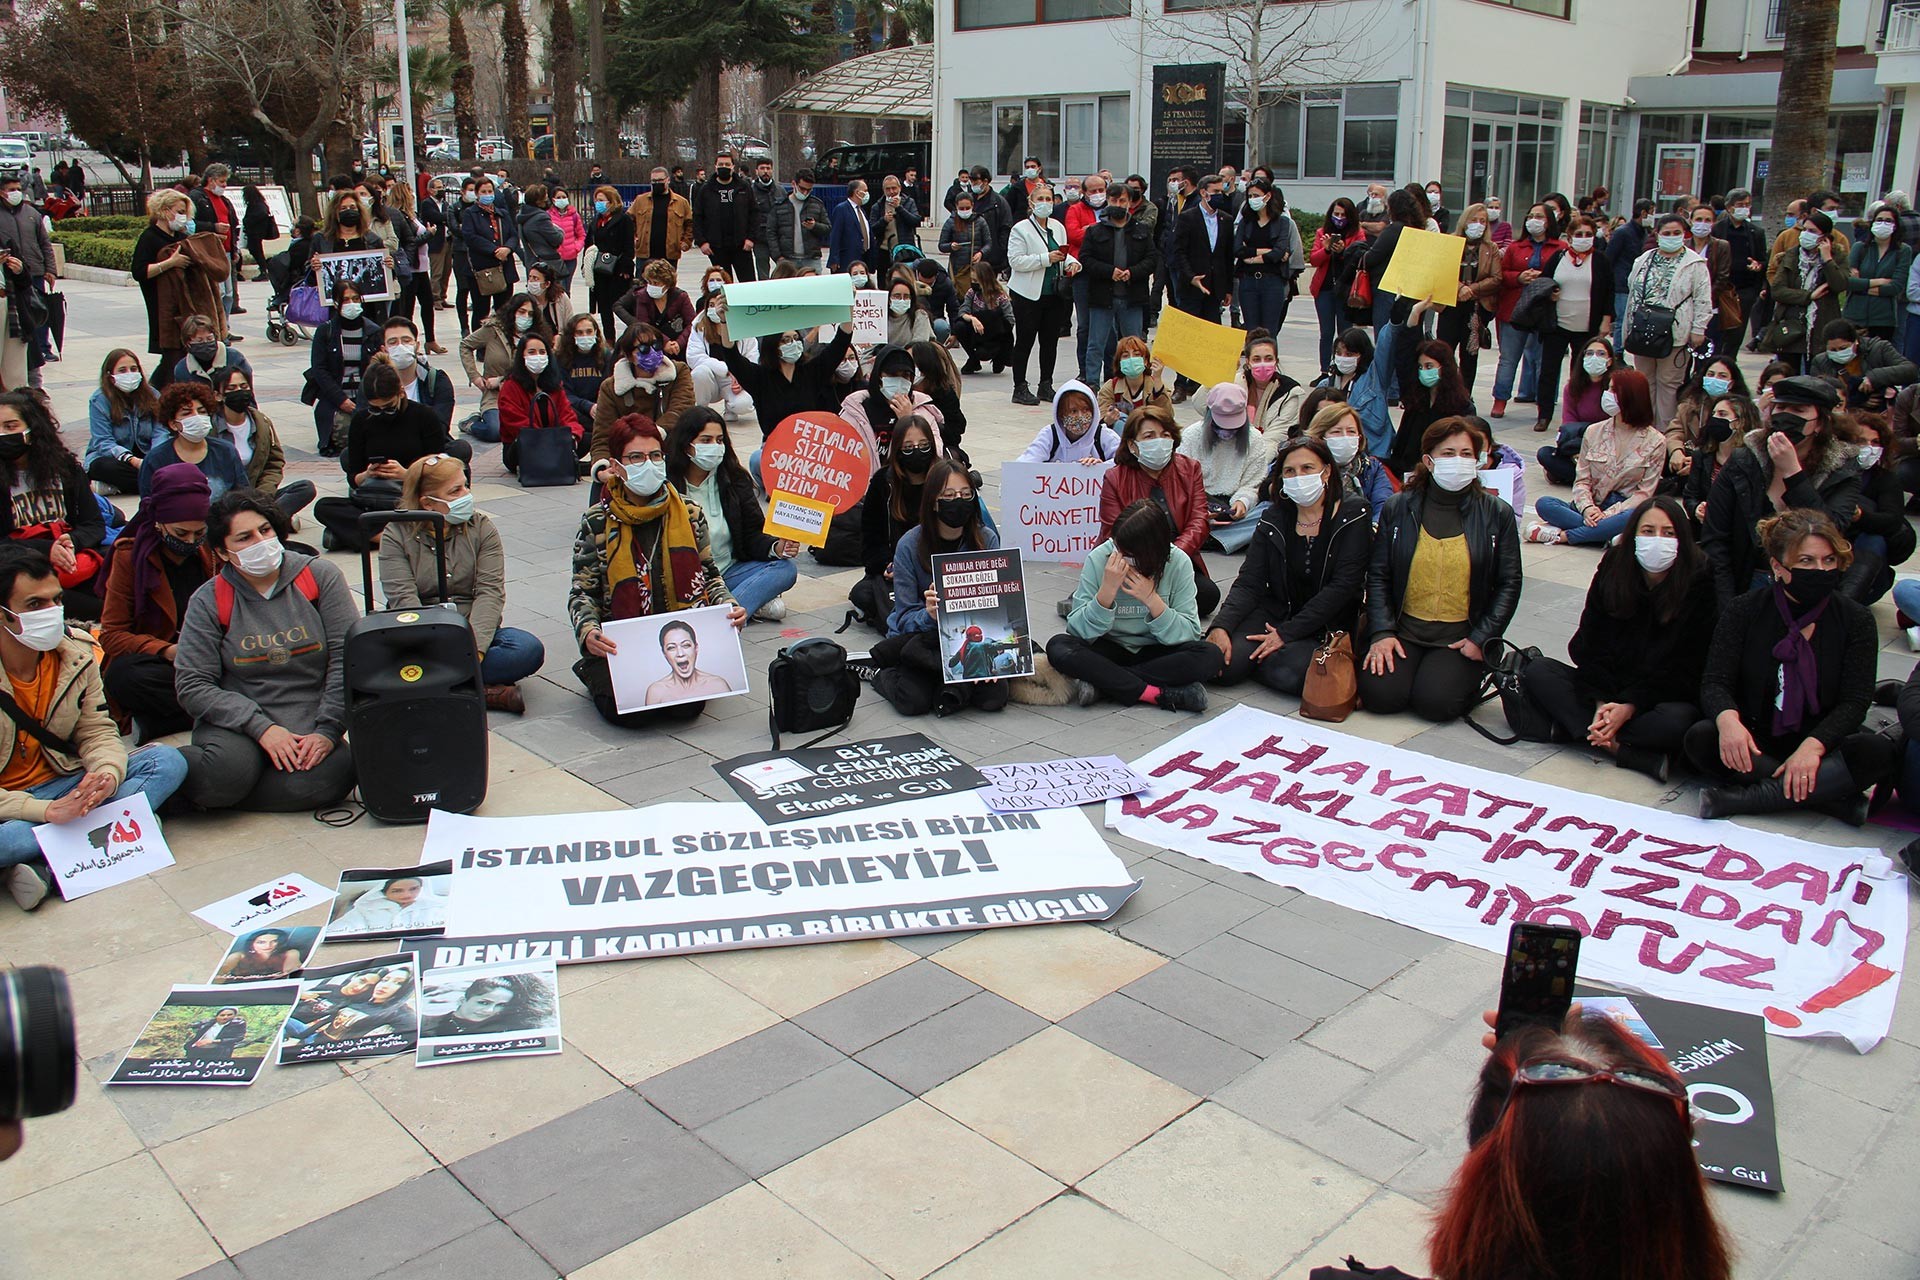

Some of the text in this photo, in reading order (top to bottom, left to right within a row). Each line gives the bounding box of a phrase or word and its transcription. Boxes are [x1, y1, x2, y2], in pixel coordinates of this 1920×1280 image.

[793, 418, 864, 459] FETVALAR
[795, 438, 834, 465] SİZİN
[776, 472, 819, 499] BİZİM
[1032, 476, 1103, 499] KADIN
[788, 504, 807, 514] UTANÇ
[1020, 504, 1101, 526] CİNAYETL
[945, 558, 1008, 572] KADINLAR EVDE DEĞİL
[946, 571, 995, 585] SOKAKTA GÜZEL
[948, 586, 977, 598] KADINLAR
[1003, 582, 1021, 593] DEĞİL
[949, 597, 997, 610] İSYANDA GÜZEL
[1118, 605, 1135, 615] GREAT
[241, 626, 309, 651] GUCCI
[816, 747, 950, 776] ÇEKİLMEDİK
[835, 743, 891, 760] BİZ
[755, 780, 806, 801] SEN
[812, 756, 962, 789] ÇEKİLEBİLİRSİN
[978, 760, 1108, 779] STANBUL
[413, 792, 438, 803] TVM
[776, 778, 954, 816] Ekmek ve Gül
[991, 794, 1049, 809] MOR
[460, 812, 1041, 869] İSTANBUL SÖZLEŞMESİ BİZİM
[64, 858, 97, 879] اسلامی
[562, 839, 1000, 906] VAZGEÇMEYİZ!
[433, 892, 1110, 968] DENİZLİ KADINLAR BİRLİKTE GÜÇLÜ
[128, 1069, 155, 1077] است
[1700, 1163, 1768, 1184] ve Gül
